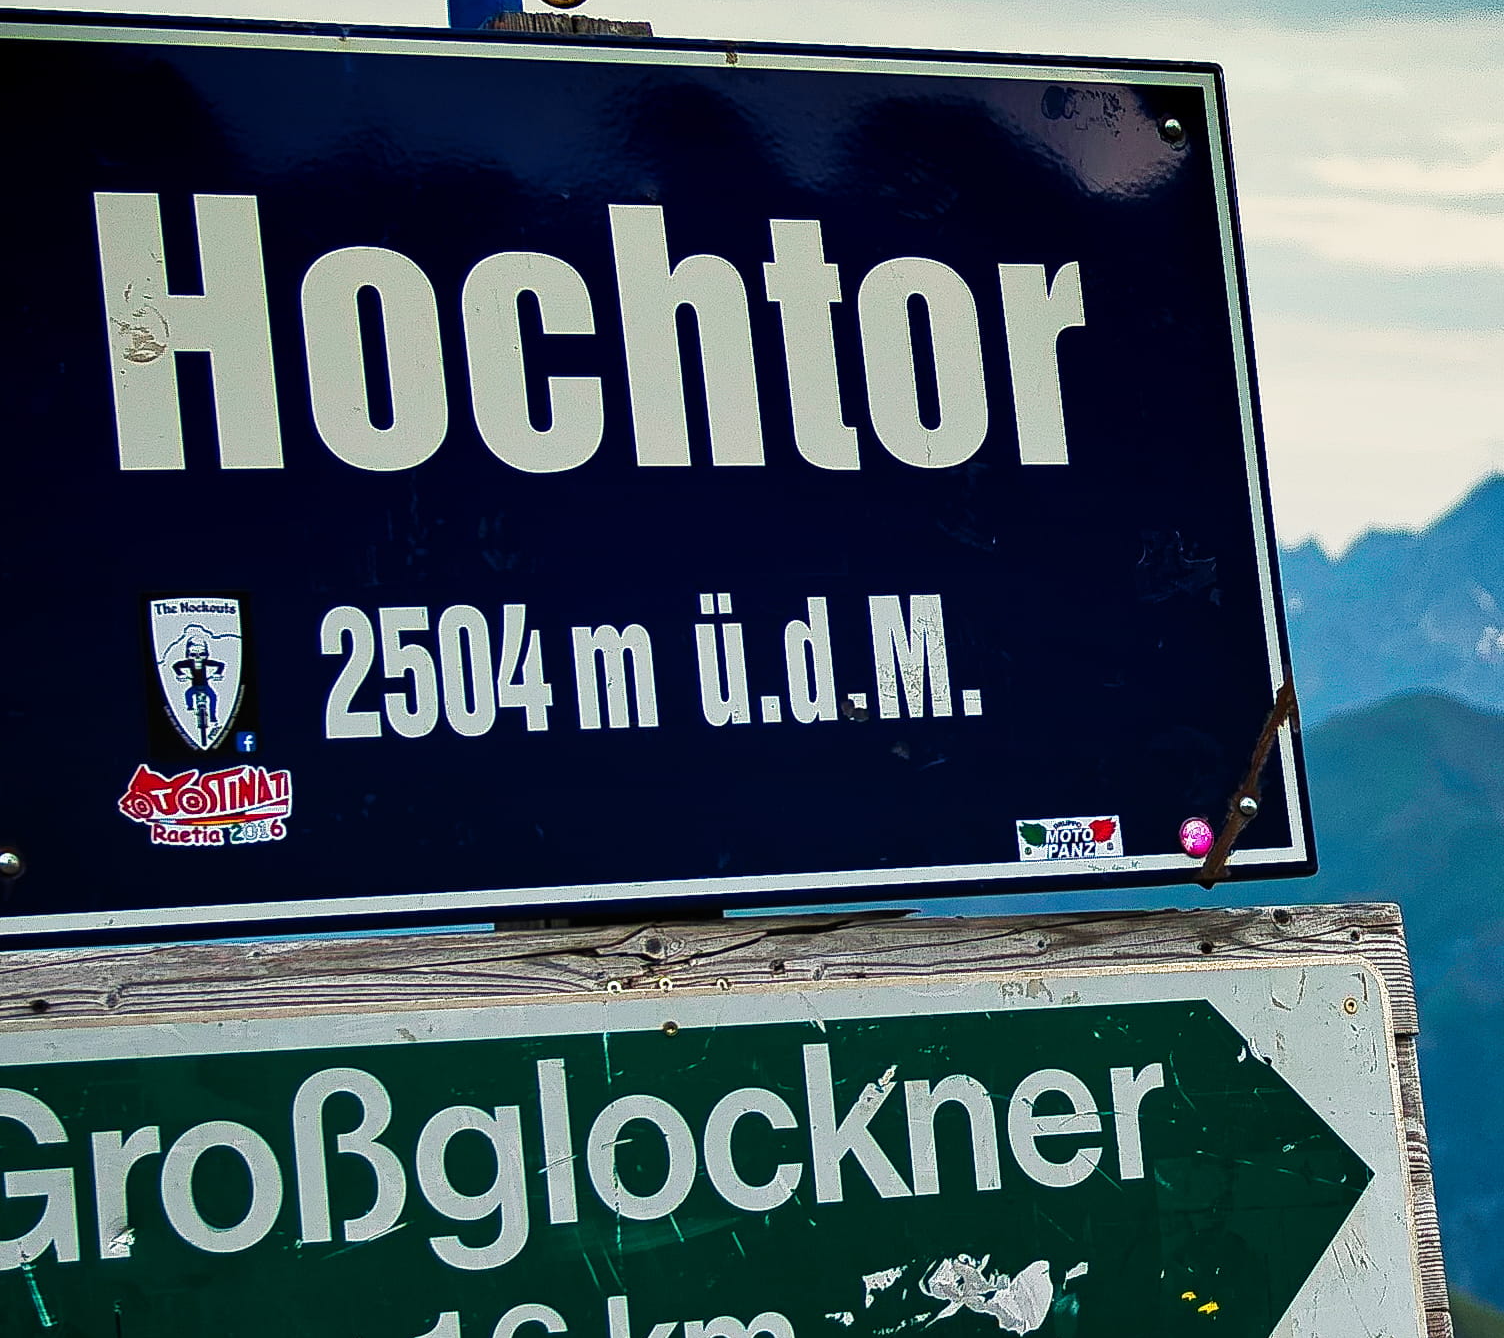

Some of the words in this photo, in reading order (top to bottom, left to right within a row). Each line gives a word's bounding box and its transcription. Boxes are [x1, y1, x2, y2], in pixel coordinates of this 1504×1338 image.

[93, 190, 1088, 474] Hochtor
[316, 602, 554, 740] 2504
[571, 623, 658, 730] m
[696, 591, 983, 726] ü.d.M.
[152, 823, 221, 844] Raetia
[230, 820, 284, 842] 2016
[1046, 828, 1094, 845] MOTO
[1048, 842, 1096, 859] PANZ
